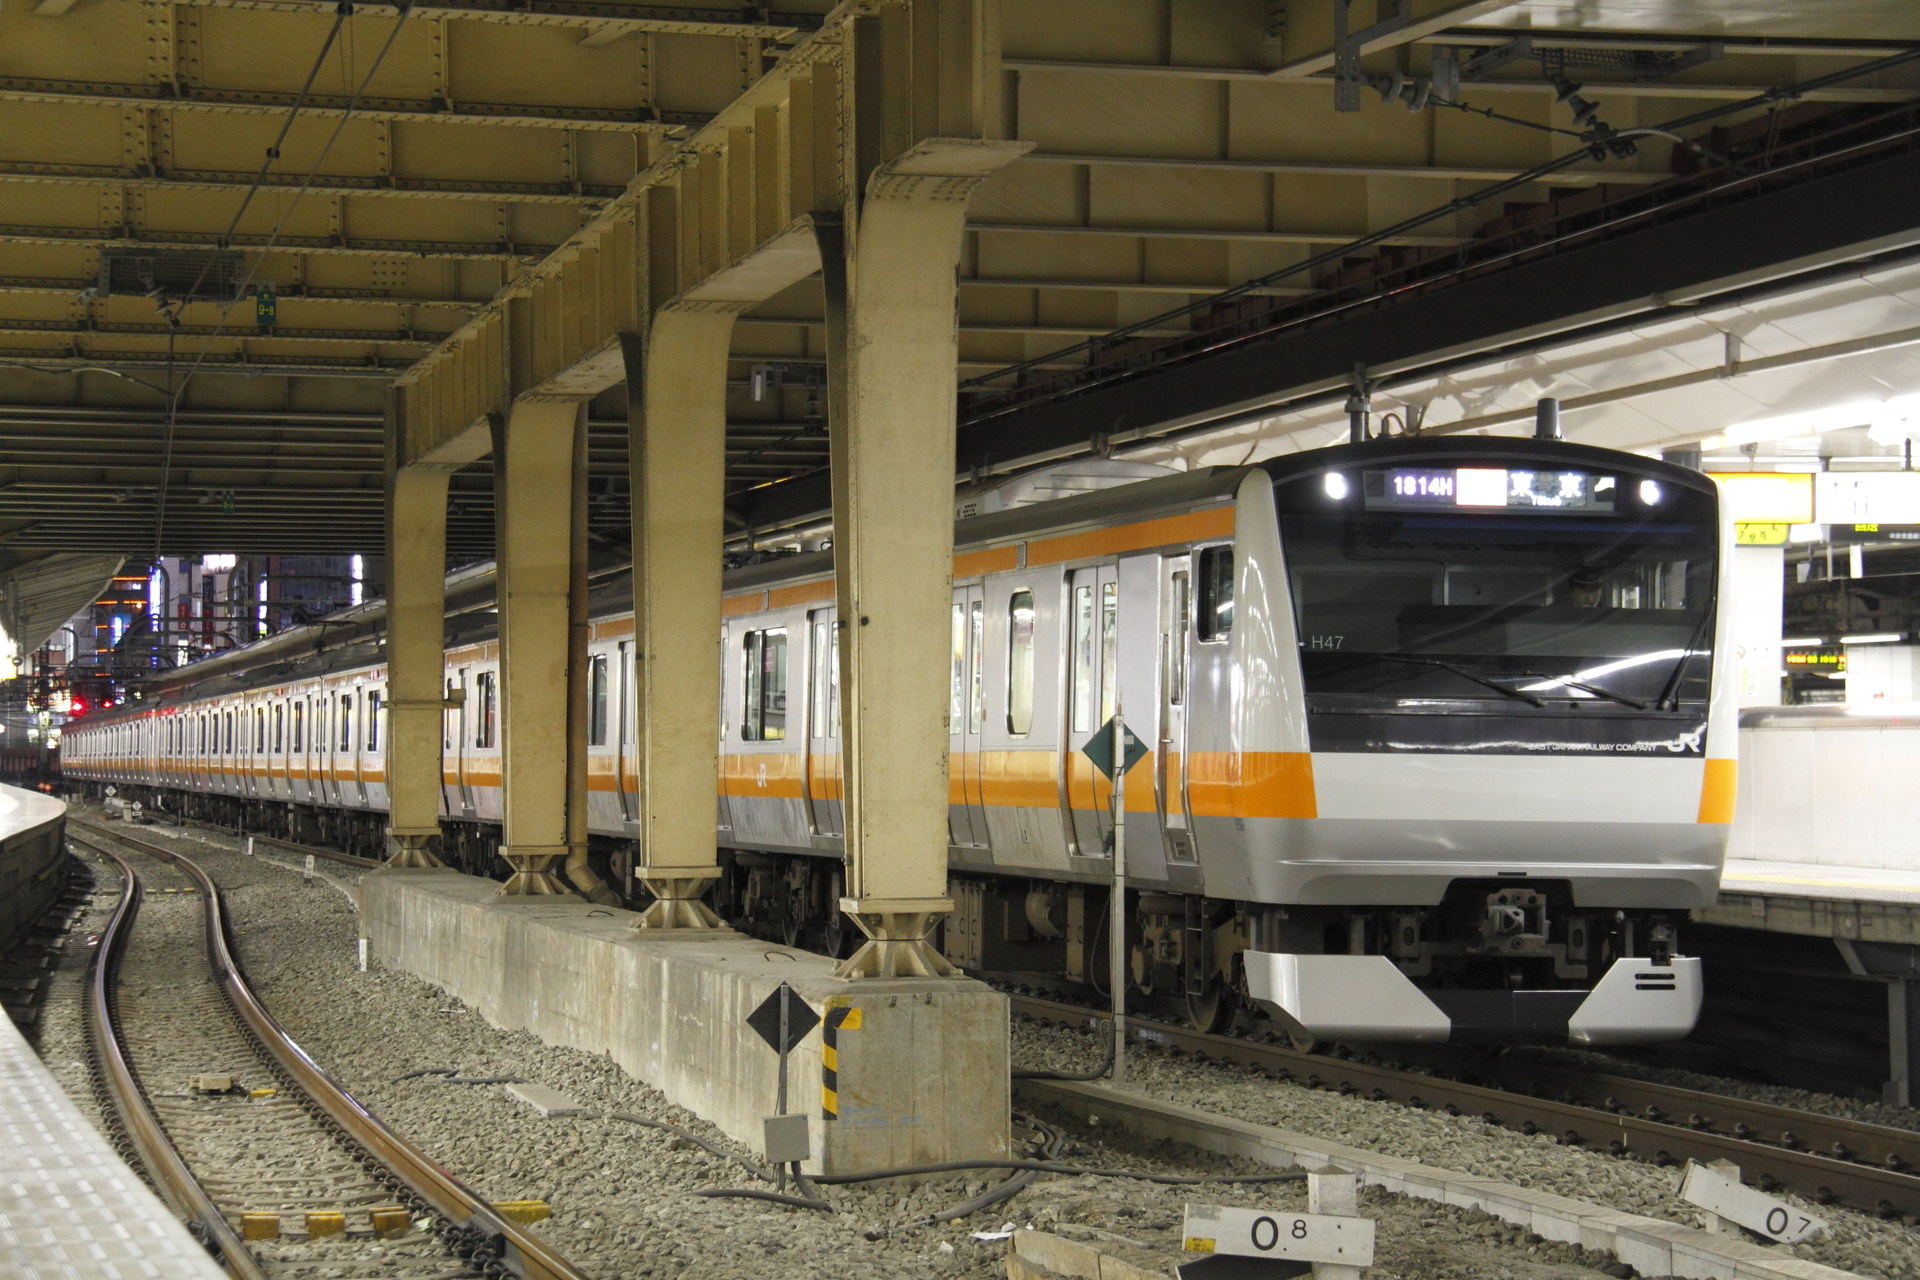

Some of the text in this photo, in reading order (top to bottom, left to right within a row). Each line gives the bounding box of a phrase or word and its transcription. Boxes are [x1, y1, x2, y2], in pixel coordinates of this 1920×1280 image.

[258, 304, 275, 316] 9-8
[1394, 476, 1453, 496] 1814H
[1510, 472, 1582, 498] 東京
[1312, 635, 1344, 650] H47
[1616, 743, 1657, 751] COMPANY
[1667, 733, 1701, 753] JR
